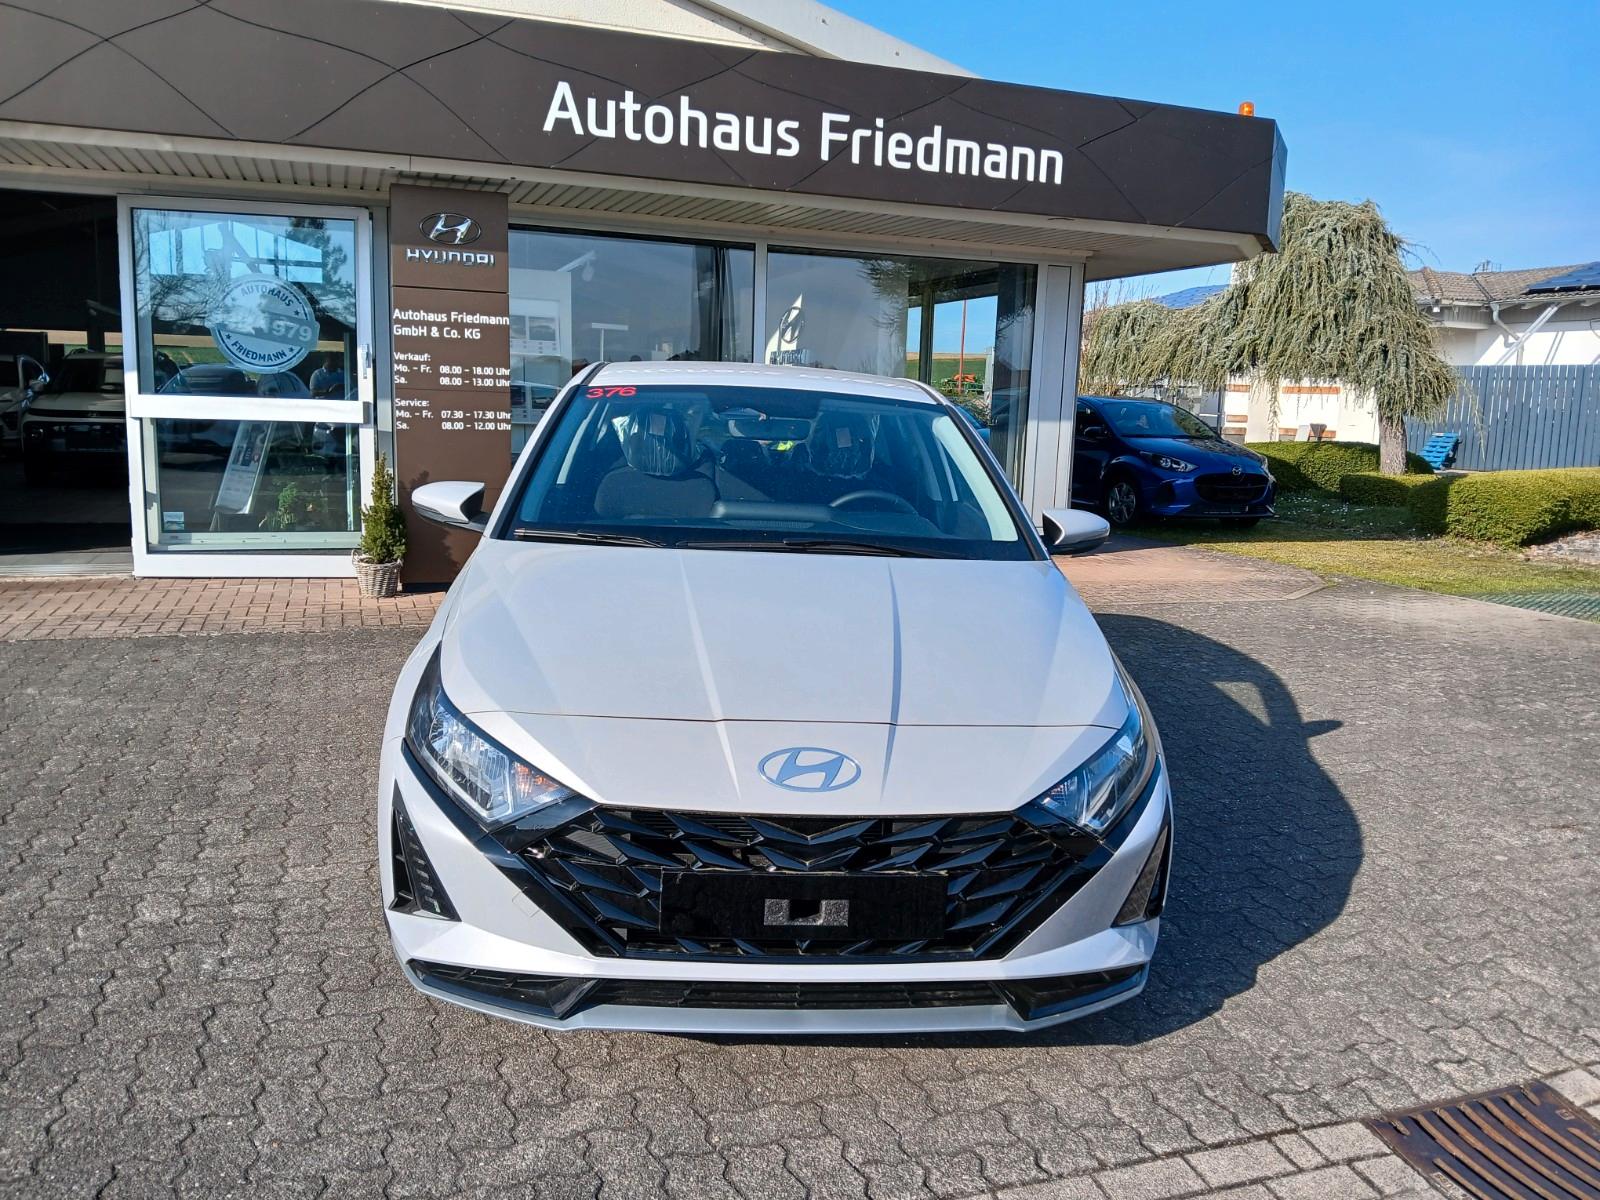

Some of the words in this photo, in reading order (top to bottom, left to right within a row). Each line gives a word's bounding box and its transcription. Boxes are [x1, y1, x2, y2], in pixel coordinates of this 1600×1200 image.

[543, 81, 800, 157] Autohaus
[820, 112, 1063, 185] Friedmann
[240, 284, 294, 307] AUTOHAUS
[393, 308, 447, 322] Autohaus
[450, 311, 510, 326] Friedmann
[393, 325, 427, 337] GmbH
[430, 326, 440, 337] &
[443, 327, 461, 338] Co.
[464, 328, 481, 339] KG
[231, 340, 287, 362] FRIEDMANN
[393, 352, 431, 361] Verkauf:
[394, 364, 410, 372] Mo.
[420, 364, 432, 373] Fr.
[495, 367, 511, 376] Uhr
[394, 375, 408, 384] Sa.
[472, 378, 494, 386] 13.00
[495, 378, 511, 387] Uhr
[586, 385, 637, 399] 376
[394, 398, 430, 407] Service:
[395, 410, 412, 418] Mo.
[422, 410, 434, 418] Fr.
[441, 410, 463, 419] 07.30
[473, 411, 495, 419] 17.30
[496, 411, 512, 419] Uhr
[396, 421, 409, 429] Sa.
[474, 422, 495, 430] 12.00
